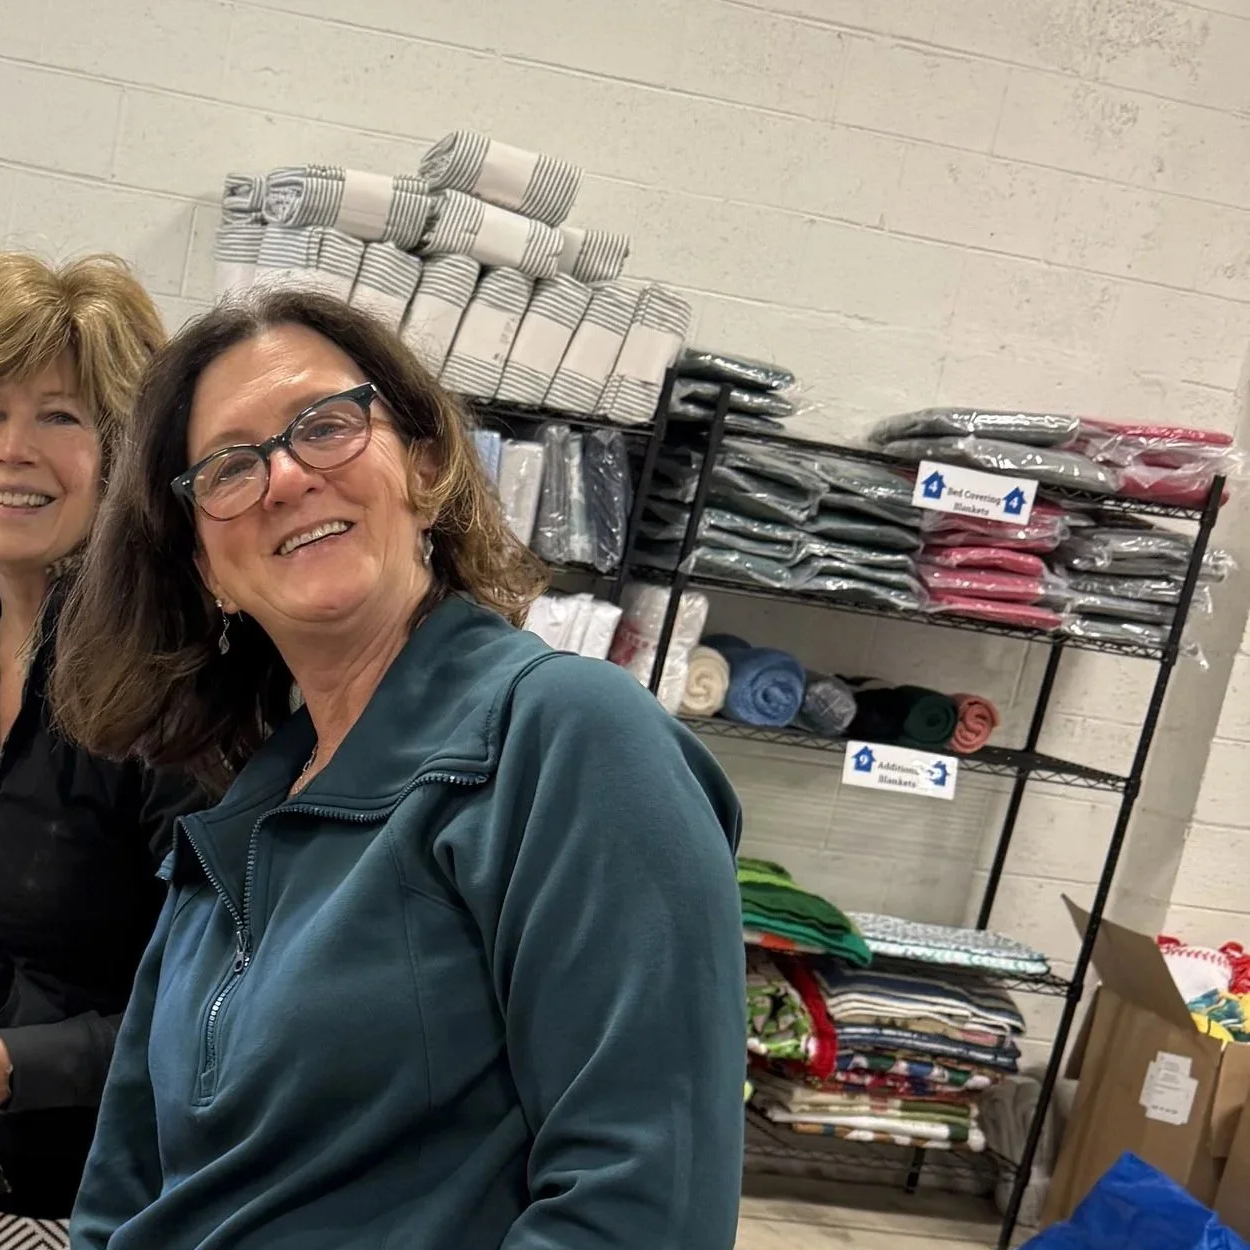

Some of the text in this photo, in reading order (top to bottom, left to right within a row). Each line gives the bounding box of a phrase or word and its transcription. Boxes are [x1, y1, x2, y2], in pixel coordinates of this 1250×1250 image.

[928, 480, 939, 493] 4
[947, 487, 1002, 506] Bed Covering
[1008, 496, 1019, 509] 4
[953, 502, 990, 516] Blankets
[859, 755, 869, 766] 9
[877, 774, 918, 788] Blankets
